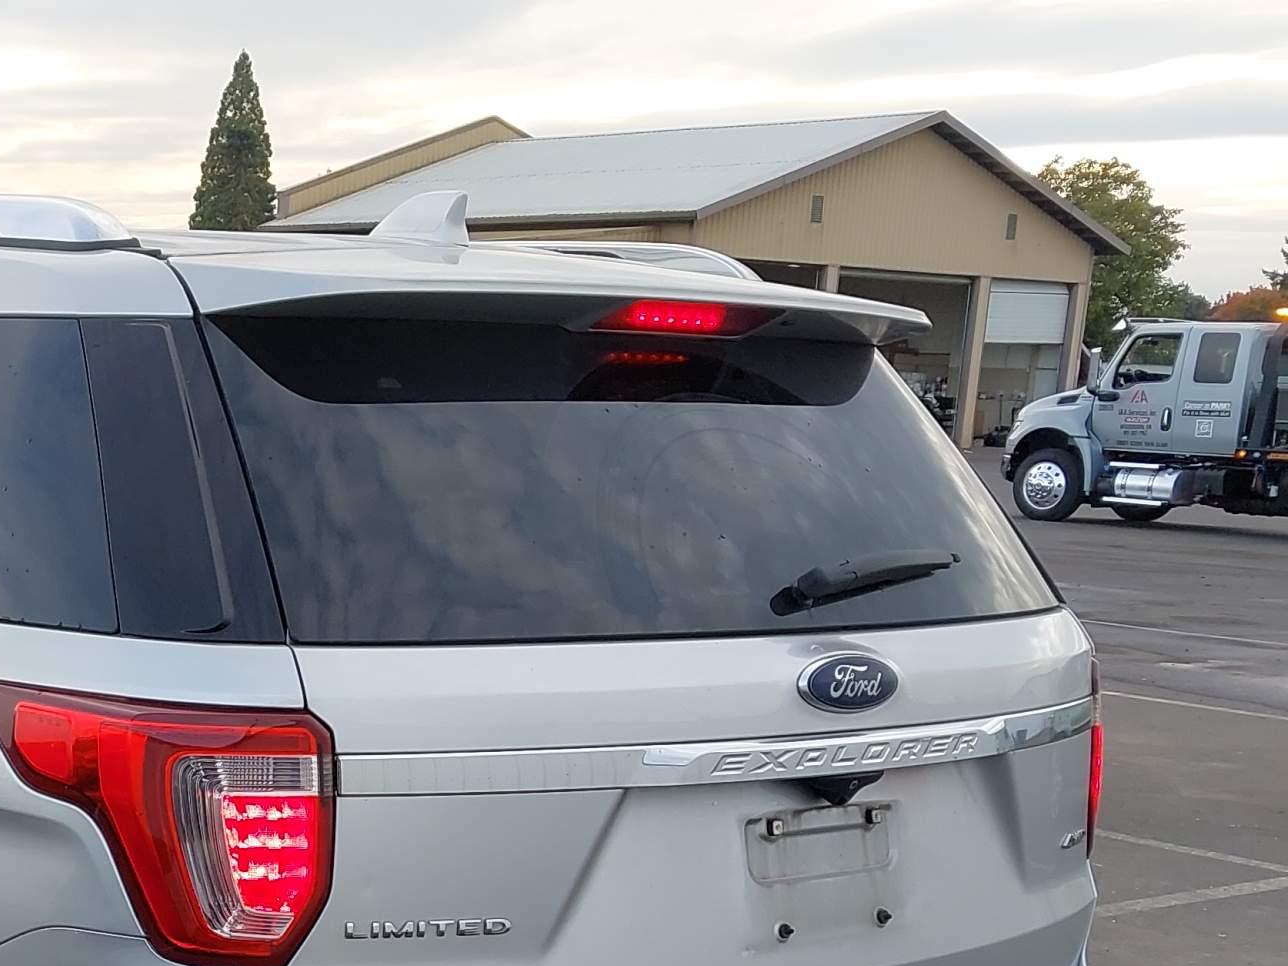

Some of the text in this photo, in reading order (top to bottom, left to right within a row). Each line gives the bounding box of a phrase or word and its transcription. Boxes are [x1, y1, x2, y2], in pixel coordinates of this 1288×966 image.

[830, 664, 882, 698] Ford
[710, 732, 978, 776] EXPLORER
[344, 917, 513, 940] LIMITED
